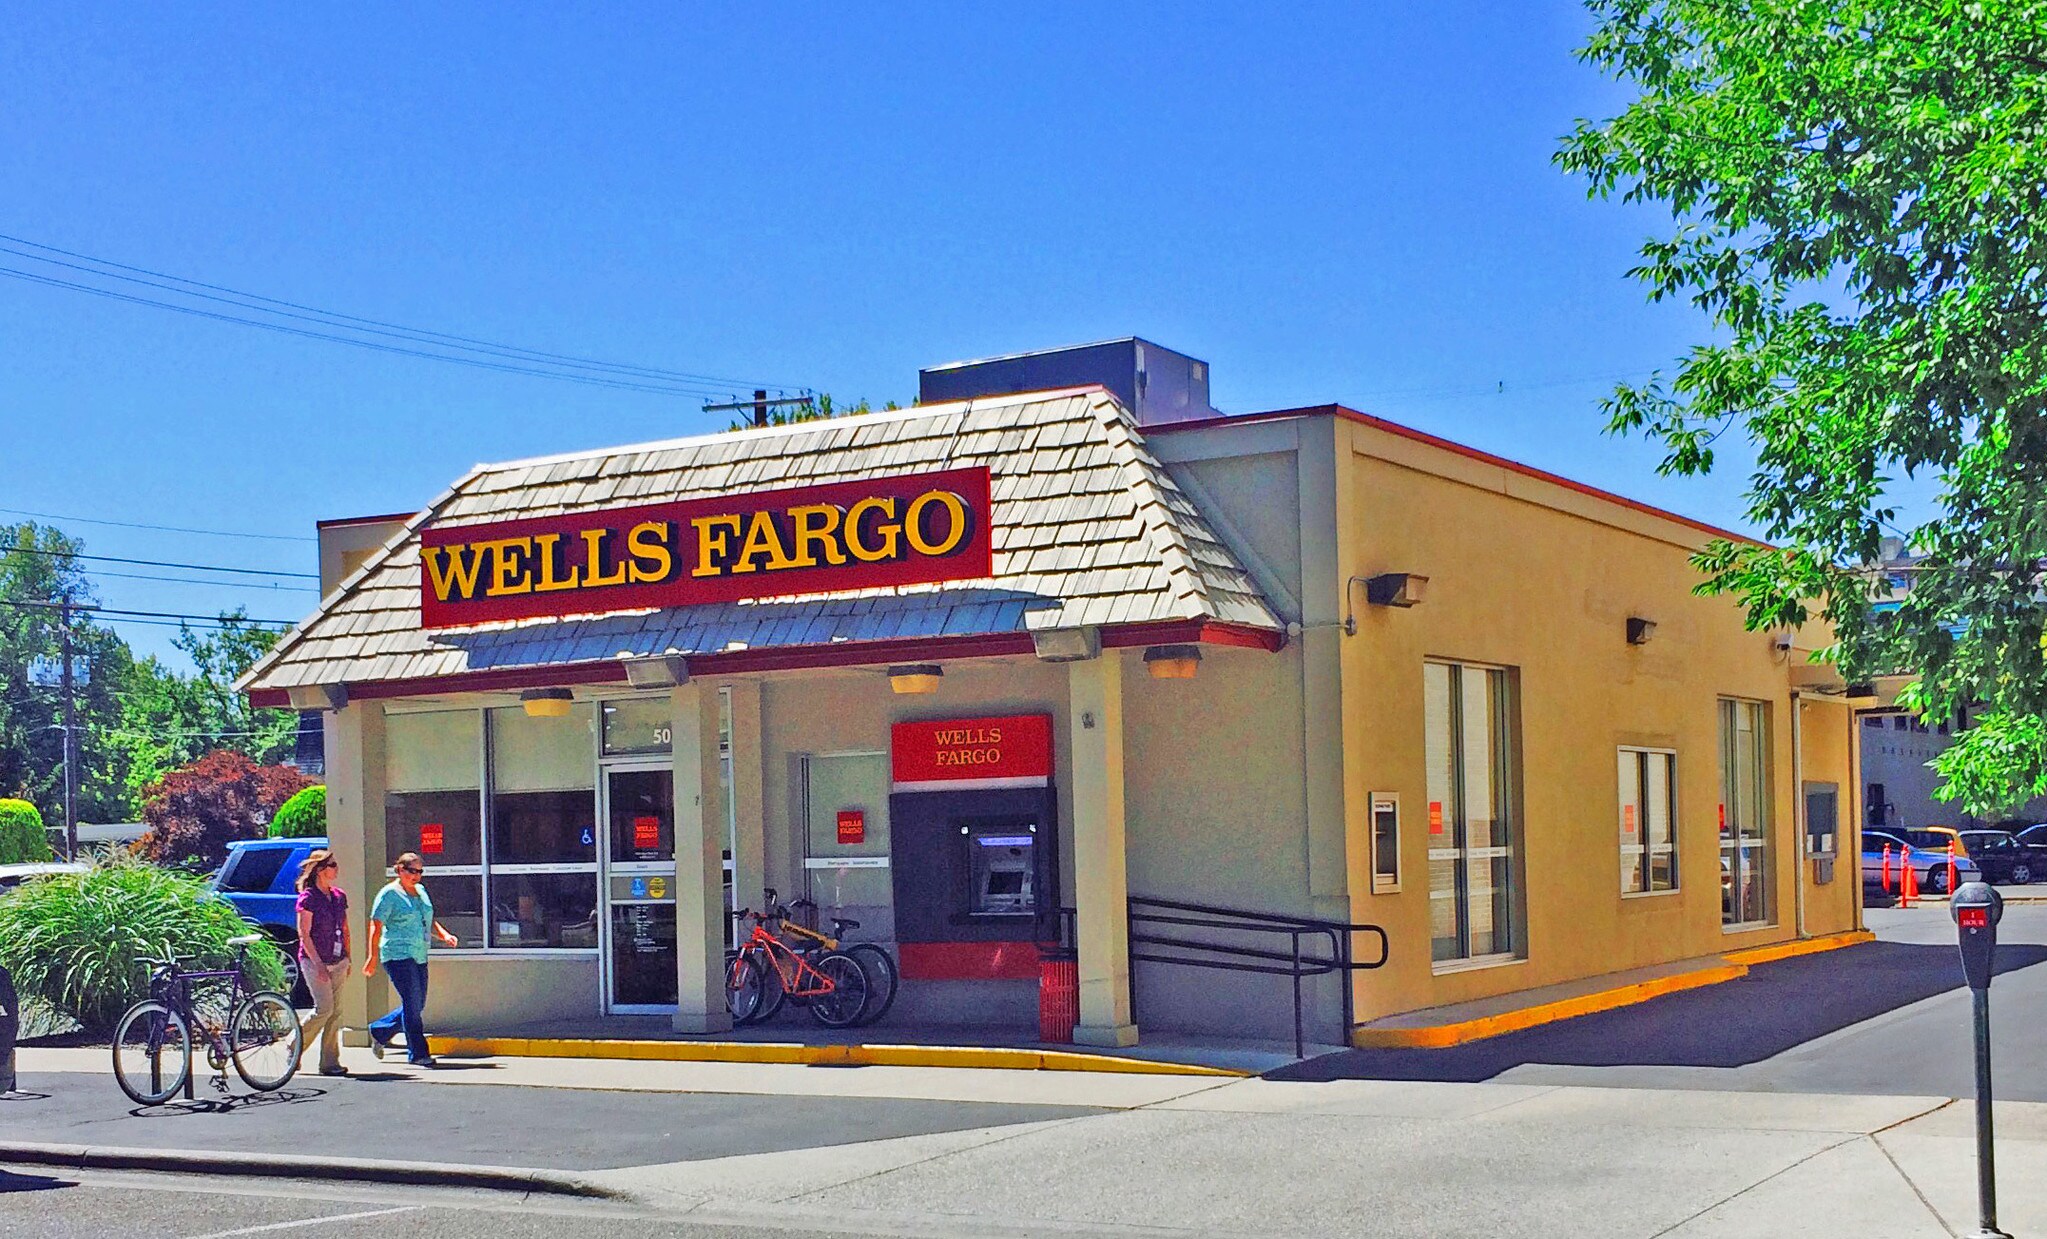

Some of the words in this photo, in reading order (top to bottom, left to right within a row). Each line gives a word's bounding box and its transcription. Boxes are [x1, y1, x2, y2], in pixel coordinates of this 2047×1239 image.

[420, 521, 672, 602] WELLS
[691, 488, 967, 578] FARGO
[934, 728, 1002, 746] WELLS
[936, 748, 1001, 766] FARGO
